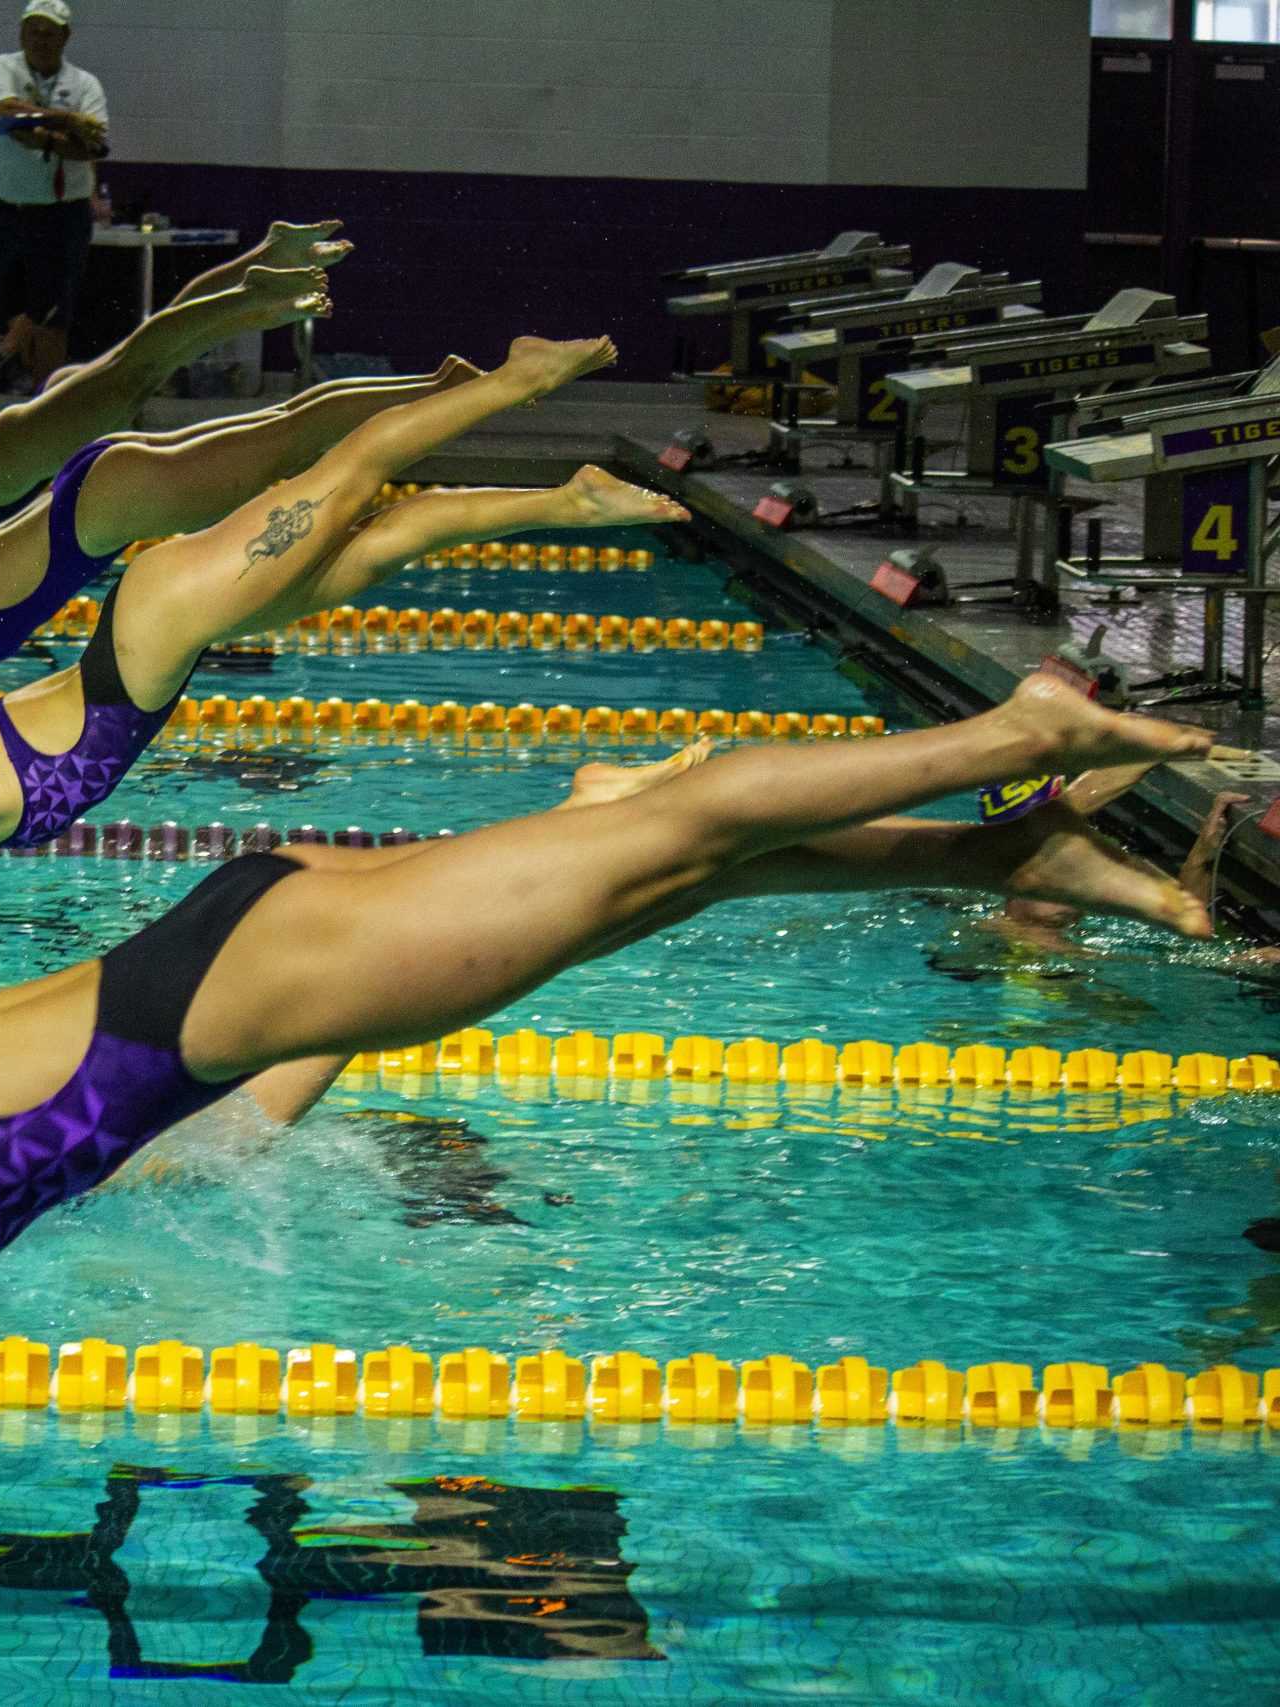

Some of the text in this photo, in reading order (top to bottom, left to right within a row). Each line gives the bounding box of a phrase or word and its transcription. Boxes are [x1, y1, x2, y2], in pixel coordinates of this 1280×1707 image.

[880, 315, 967, 337] TIGERS
[1020, 352, 1120, 376] TIGERS
[868, 380, 898, 422] 2
[1002, 426, 1040, 475] 3
[1192, 505, 1239, 560] 4
